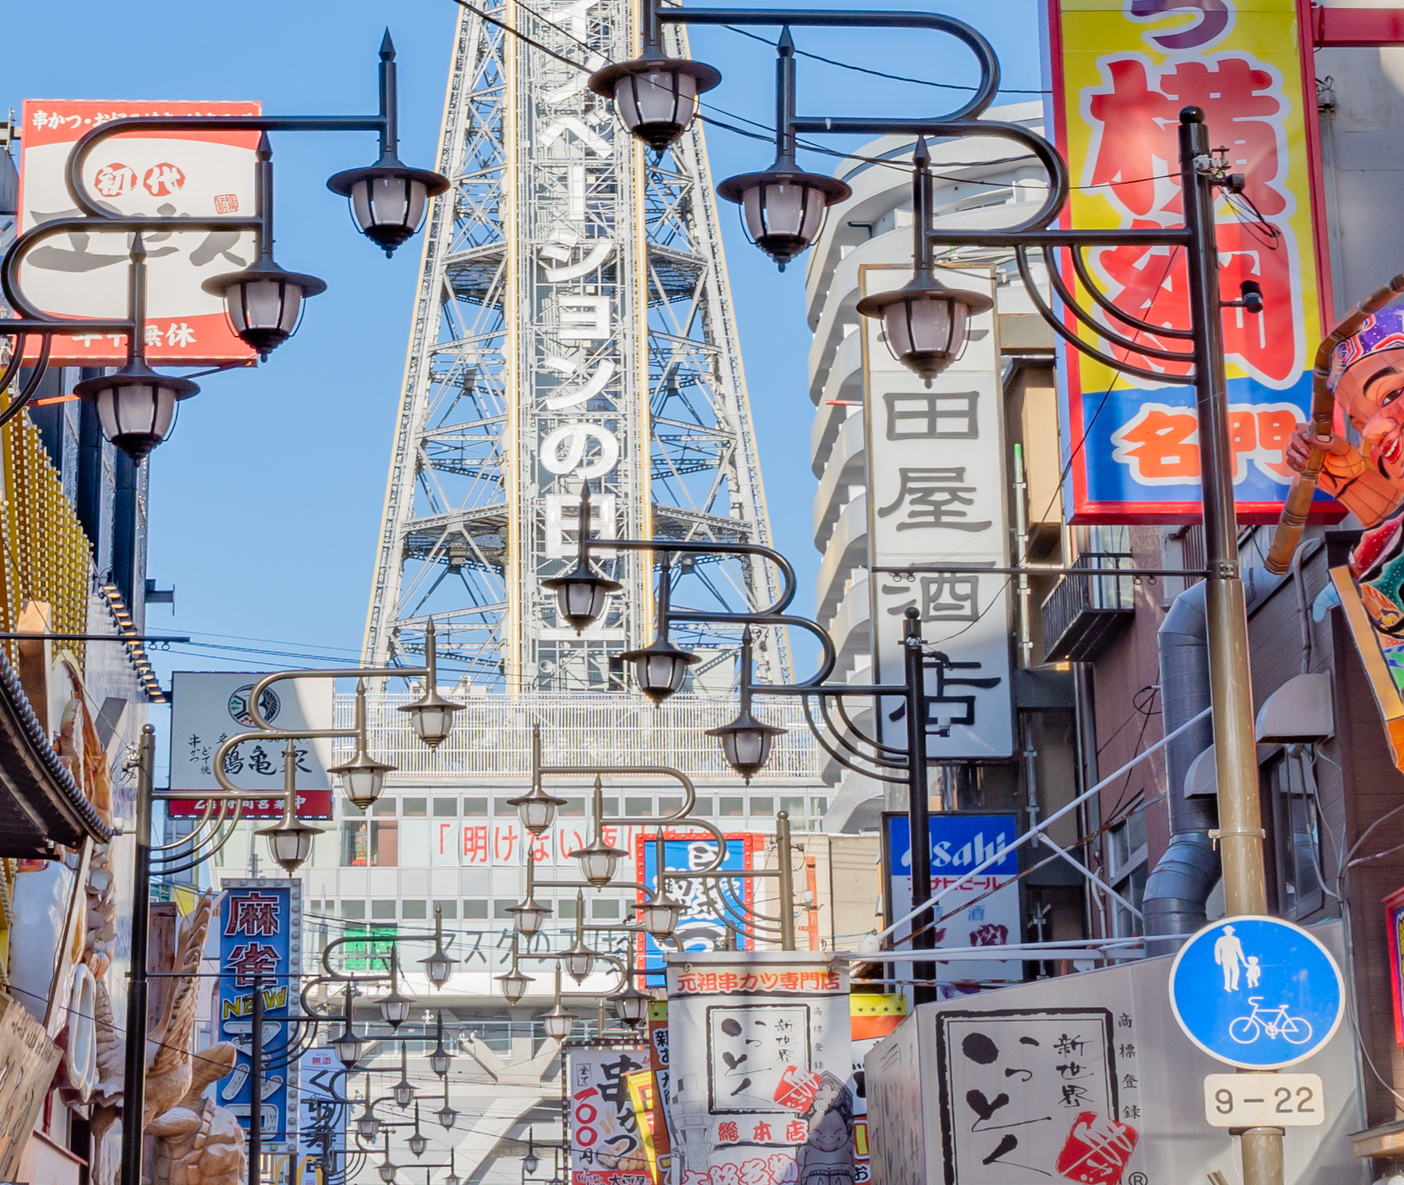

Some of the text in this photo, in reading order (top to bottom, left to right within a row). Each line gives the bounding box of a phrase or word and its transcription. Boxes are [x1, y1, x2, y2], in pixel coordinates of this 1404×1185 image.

[96, 163, 185, 197] 初代
[1118, 410, 1299, 478] 名門
[877, 328, 1001, 726] 田屋酒店
[439, 824, 633, 863] 「明けない
[224, 891, 283, 987] 麻雀
[677, 972, 841, 993] 元祖串カツ専門店
[1053, 1033, 1095, 1108] 新世界
[1118, 1012, 1142, 1120] 商標登録
[596, 1054, 643, 1157] 串かつ
[717, 1120, 808, 1142] 総本店
